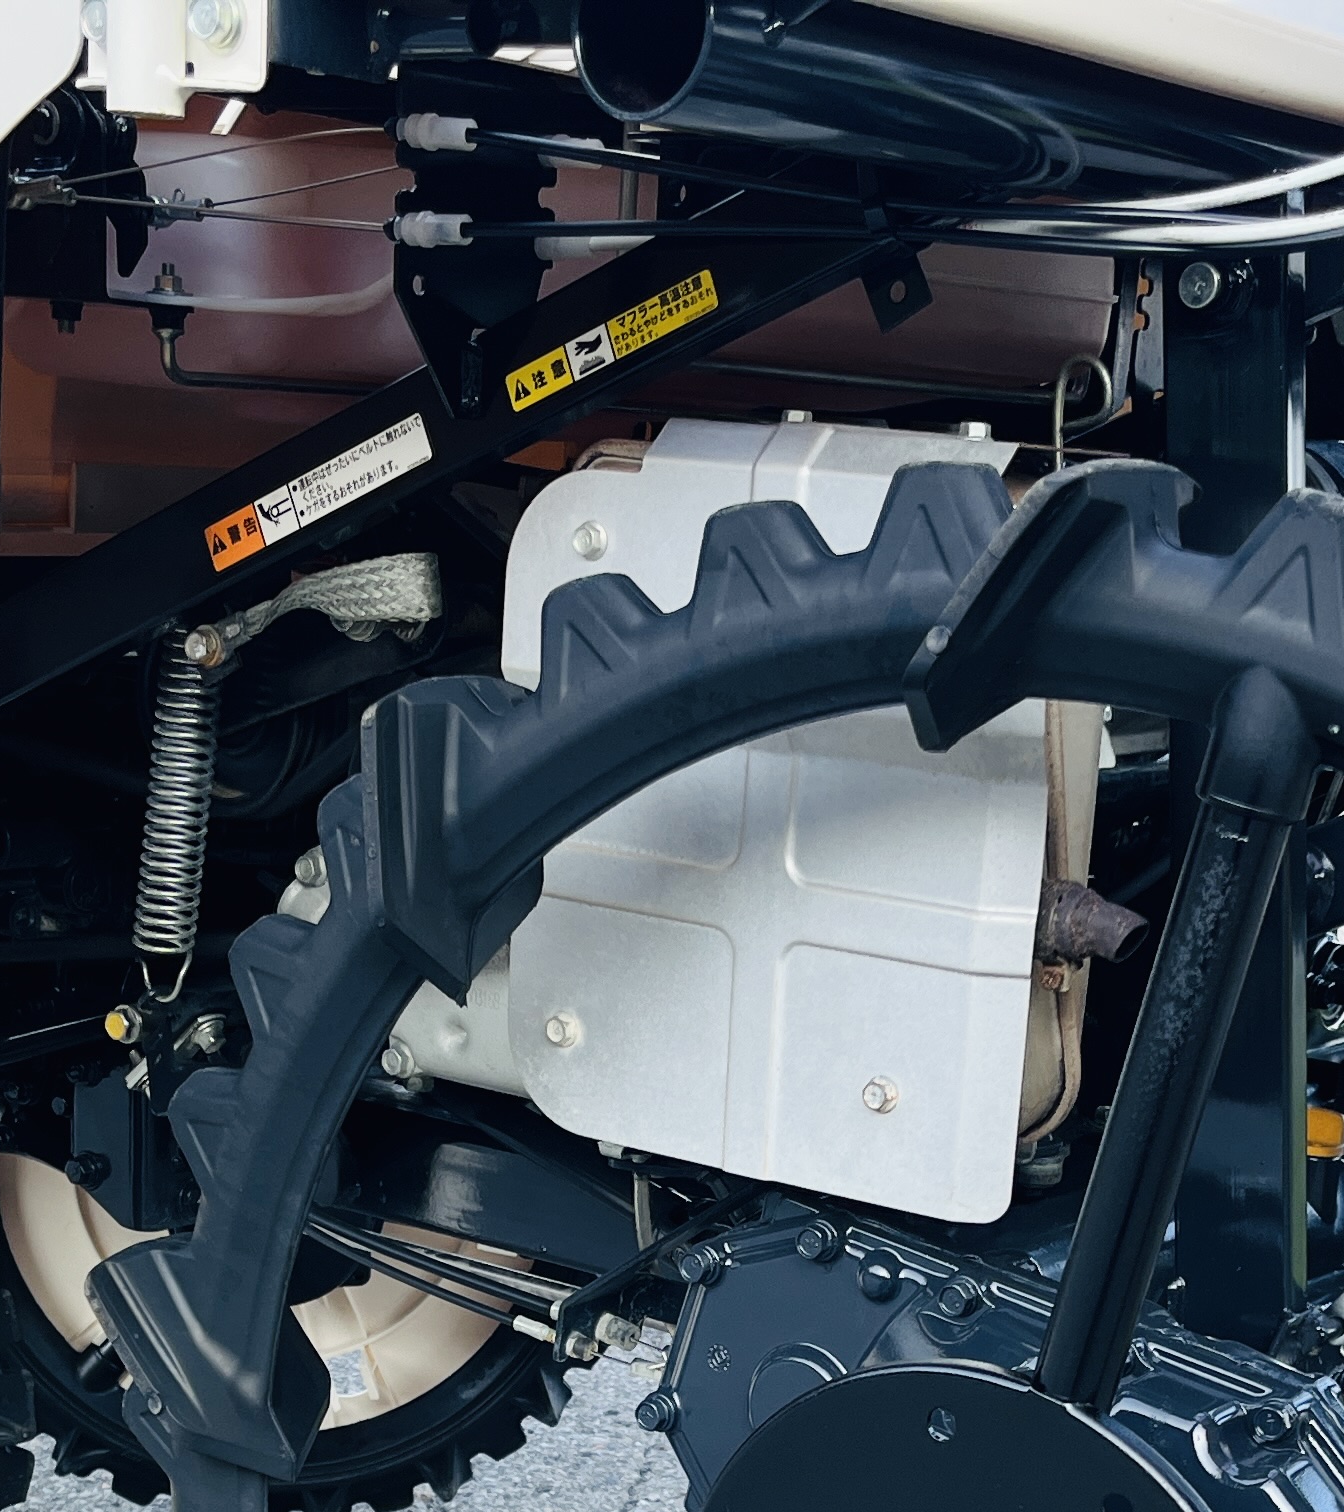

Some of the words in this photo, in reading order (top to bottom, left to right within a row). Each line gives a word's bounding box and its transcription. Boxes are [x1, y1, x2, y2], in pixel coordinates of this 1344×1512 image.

[616, 275, 702, 328] マフラー高温注意
[532, 359, 568, 390] 注意
[227, 516, 257, 546] 警告
